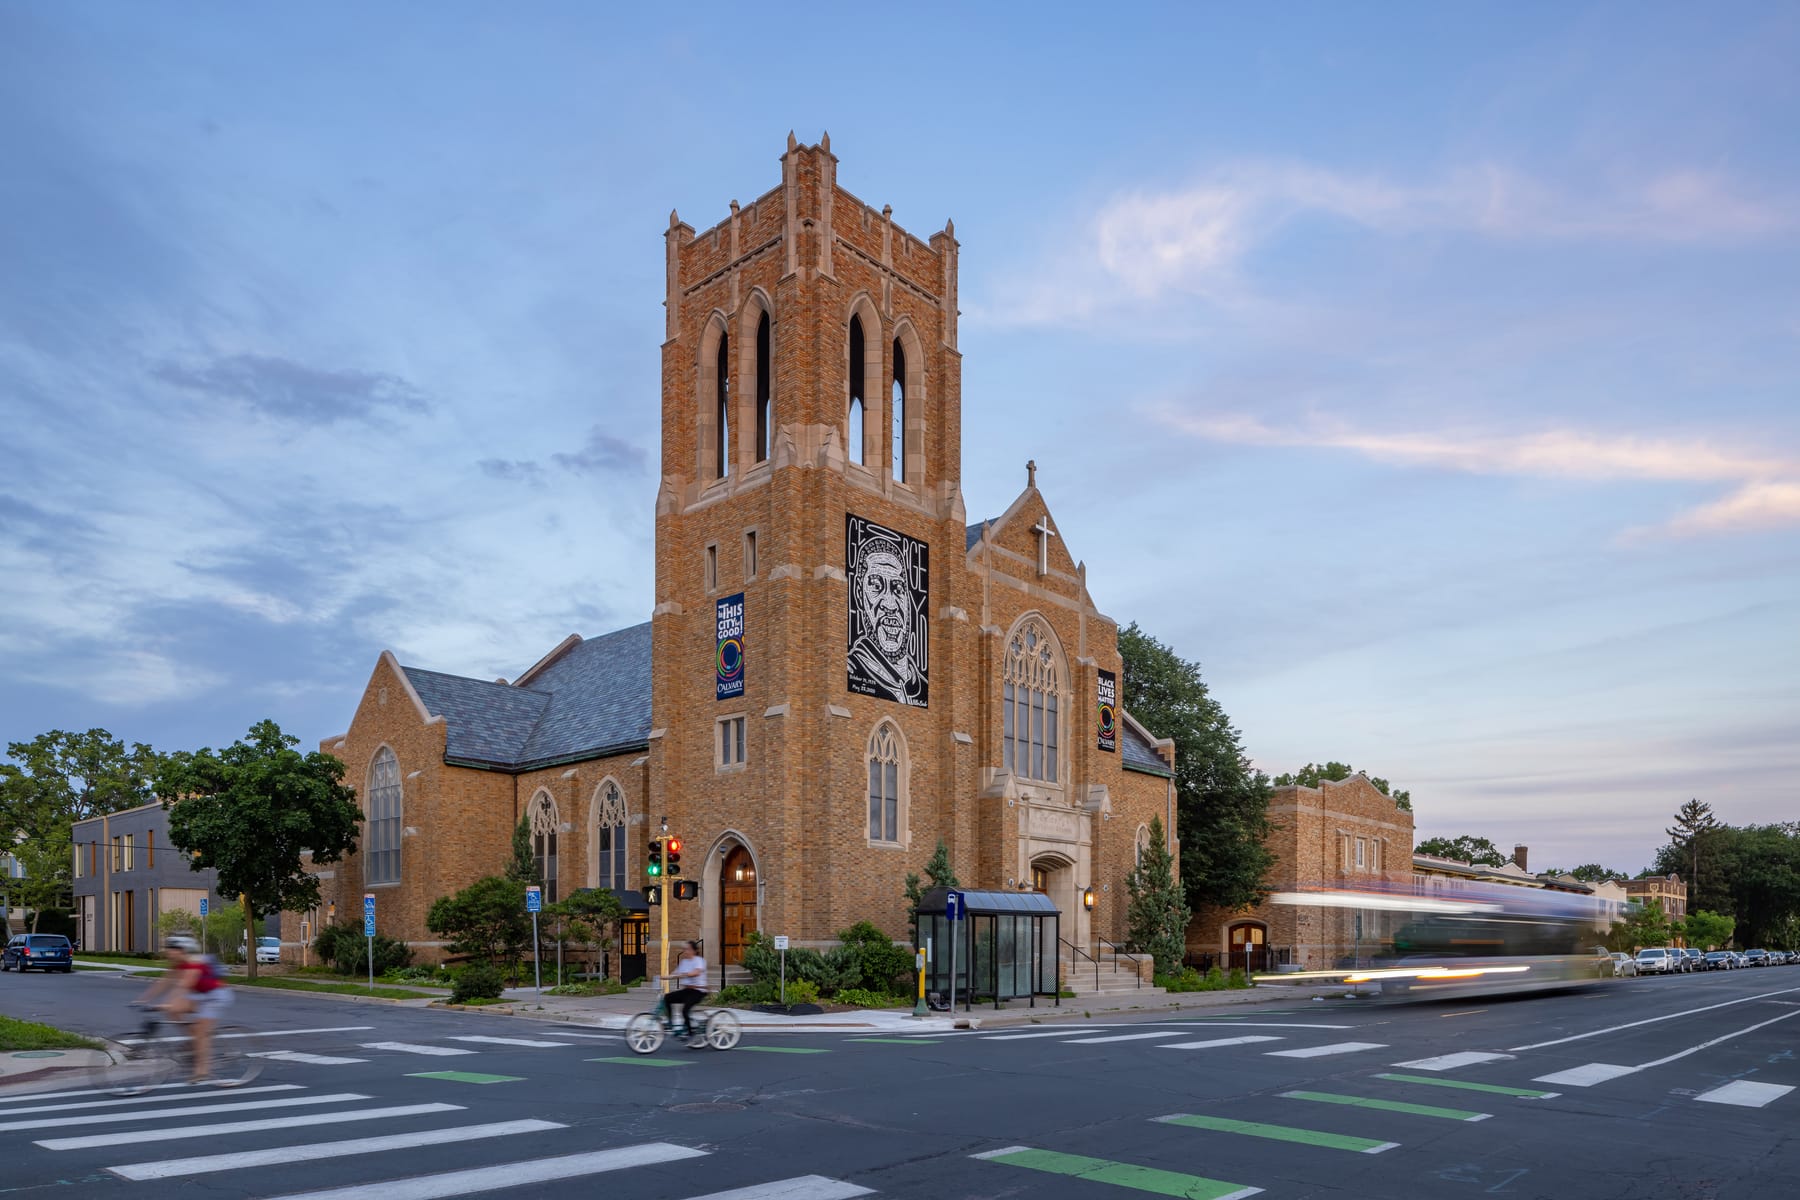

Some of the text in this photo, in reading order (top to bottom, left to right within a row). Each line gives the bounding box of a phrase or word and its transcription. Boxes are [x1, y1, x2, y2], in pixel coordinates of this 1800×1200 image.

[848, 517, 927, 593] GEORGE
[718, 603, 743, 619] THIS
[718, 617, 736, 630] CITY
[717, 679, 743, 693] CALVARY
[1098, 686, 1115, 698] LIVES
